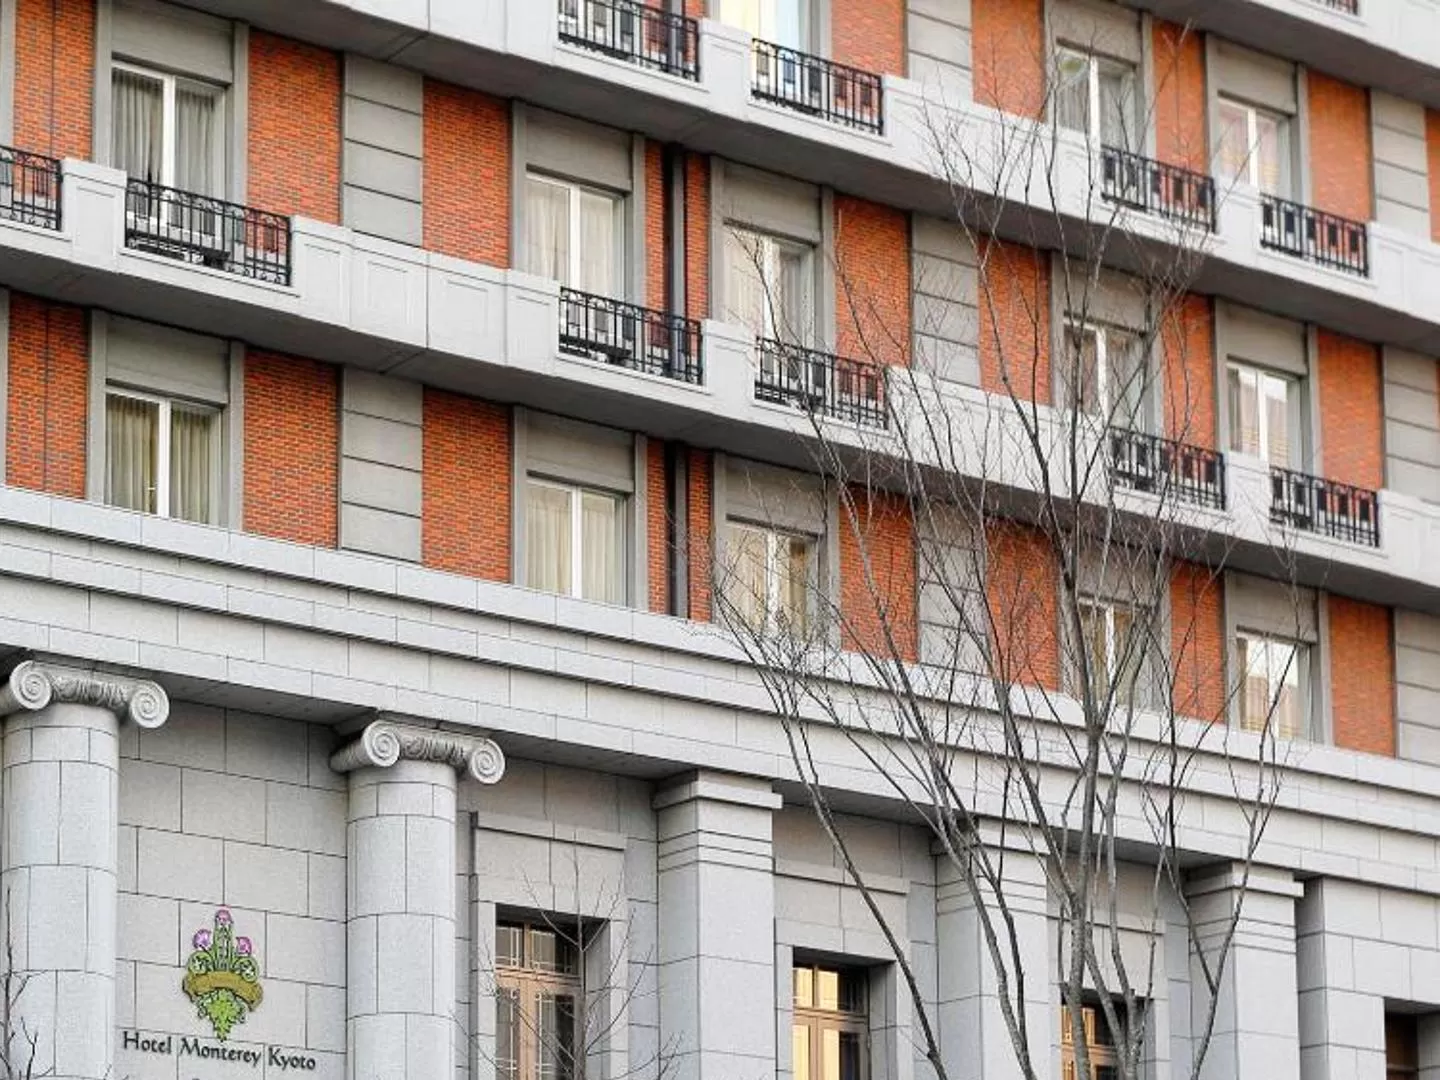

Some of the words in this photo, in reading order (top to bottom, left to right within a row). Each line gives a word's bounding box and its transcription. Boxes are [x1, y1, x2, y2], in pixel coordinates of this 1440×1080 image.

[123, 1030, 172, 1055] Hotel
[179, 1037, 262, 1068] Monterey
[267, 1046, 317, 1072] Kyoto
